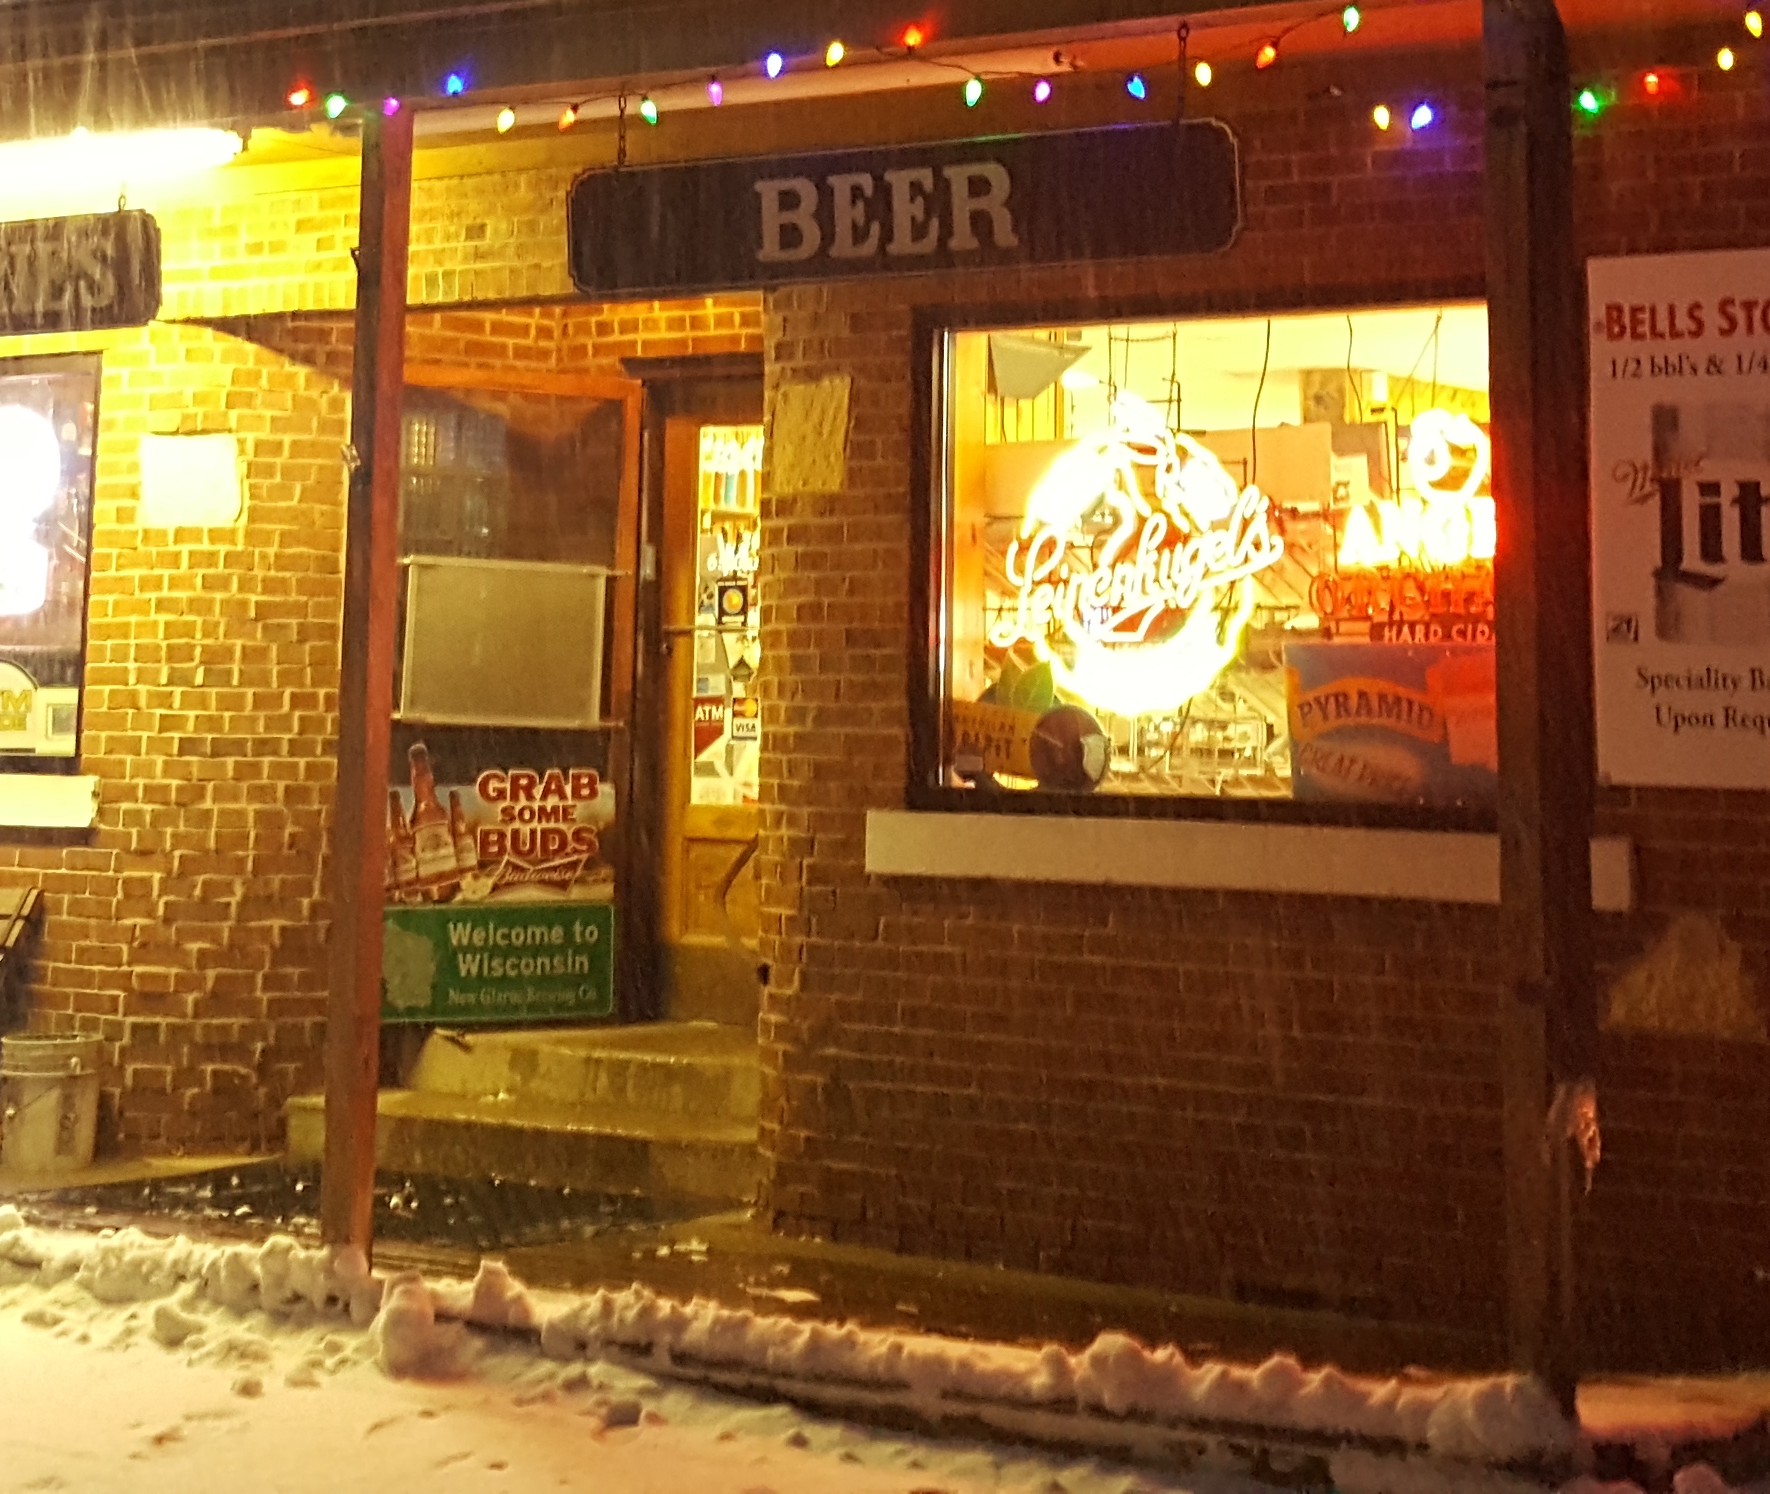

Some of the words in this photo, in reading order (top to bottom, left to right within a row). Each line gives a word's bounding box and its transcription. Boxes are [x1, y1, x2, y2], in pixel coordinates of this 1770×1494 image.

[754, 161, 1020, 263] BEER
[1605, 301, 1705, 342] BELLS
[1610, 357, 1643, 379] 1/2
[1704, 353, 1724, 376] &
[1736, 349, 1770, 375] 1/4
[989, 483, 1285, 648] Leinenkugel's
[1383, 623, 1443, 644] HARD
[1452, 623, 1496, 644] CID
[1636, 666, 1740, 699] Speciality
[695, 705, 724, 722] ATM
[1296, 689, 1434, 730] PYRAMID
[1654, 704, 1716, 736] Upon
[735, 722, 756, 734] VISA
[476, 769, 599, 805] GRAB
[499, 804, 577, 825] SOME
[477, 825, 599, 860] BUDS
[448, 919, 565, 947] Welcome
[574, 917, 599, 945] to
[457, 947, 590, 978] Wisconsin
